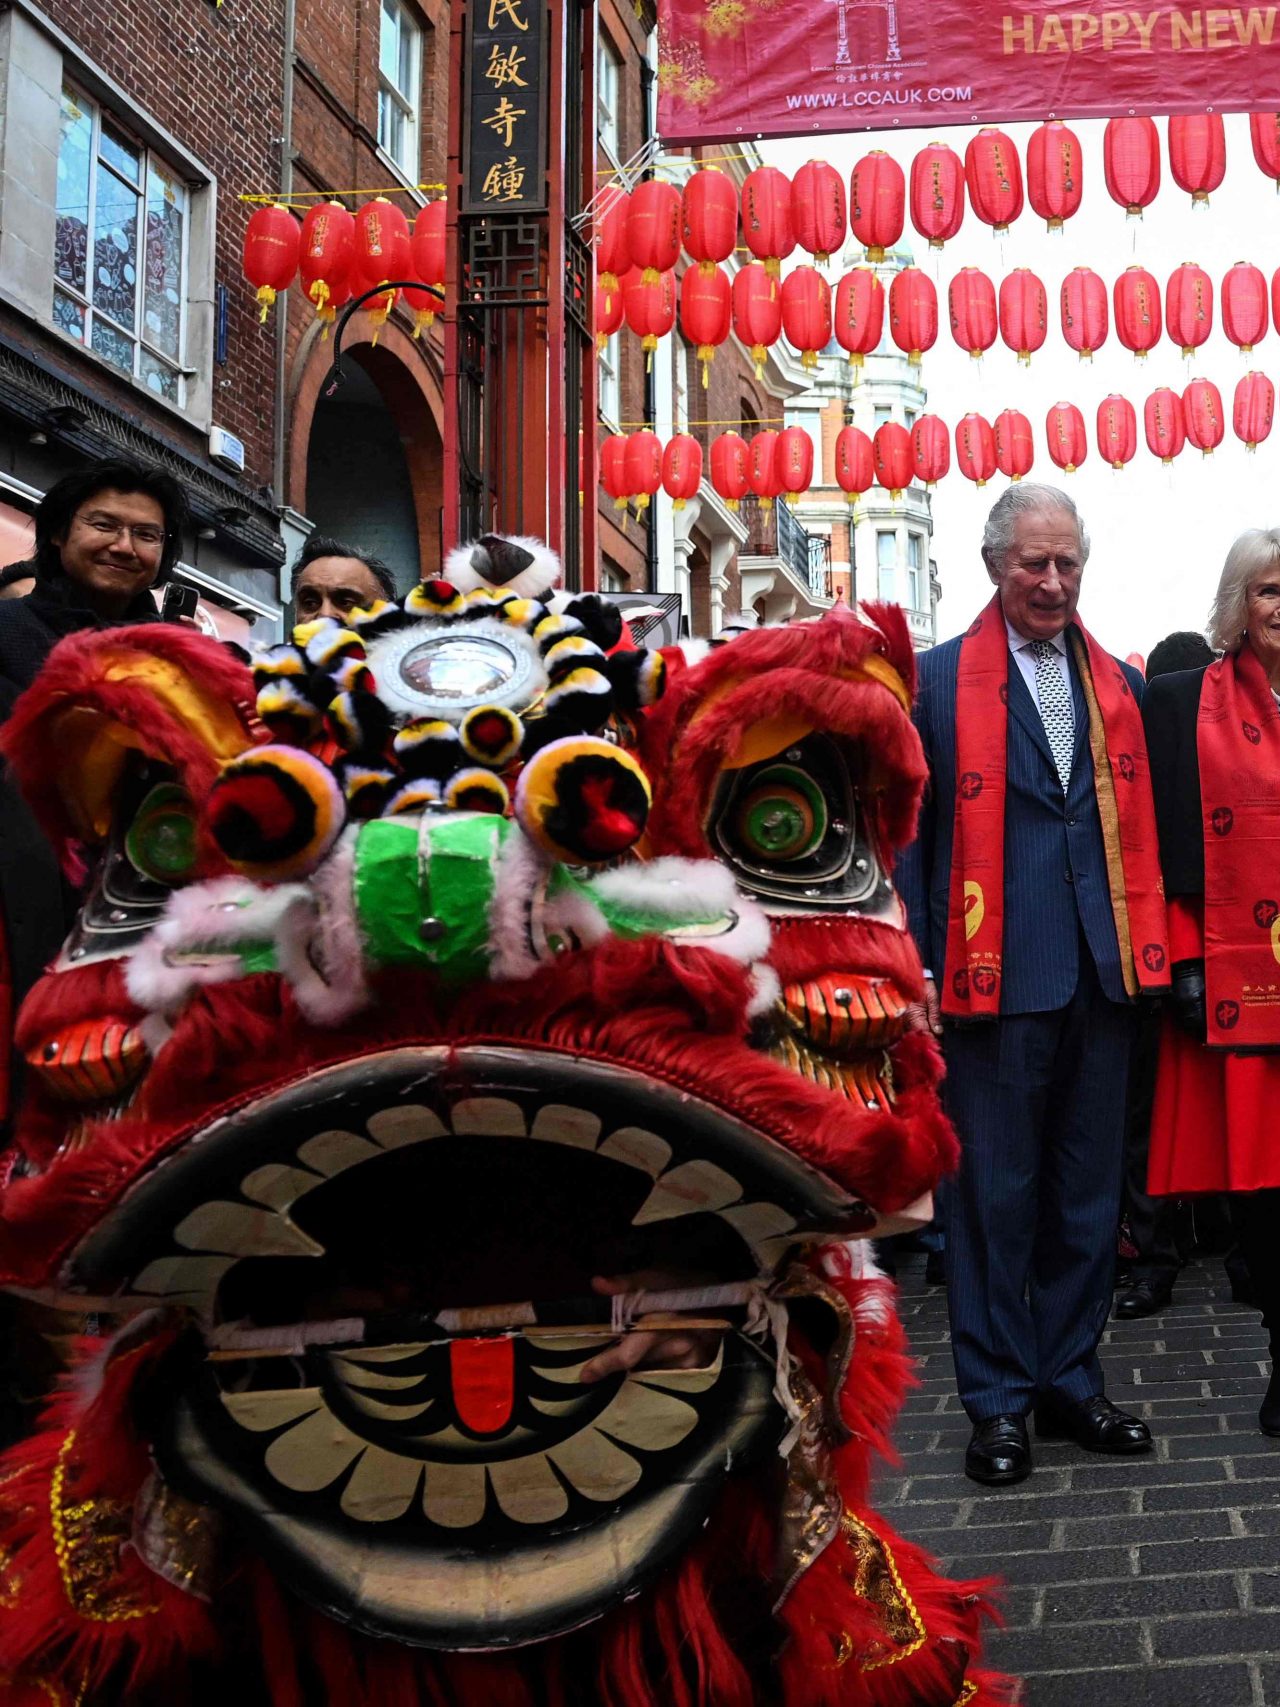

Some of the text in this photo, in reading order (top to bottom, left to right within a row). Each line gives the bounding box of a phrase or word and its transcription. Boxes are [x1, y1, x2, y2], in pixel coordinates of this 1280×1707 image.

[1002, 11, 1160, 55] HAPPY
[1170, 7, 1278, 50] NEW
[786, 86, 972, 110] WWW.LCCAUK.COM
